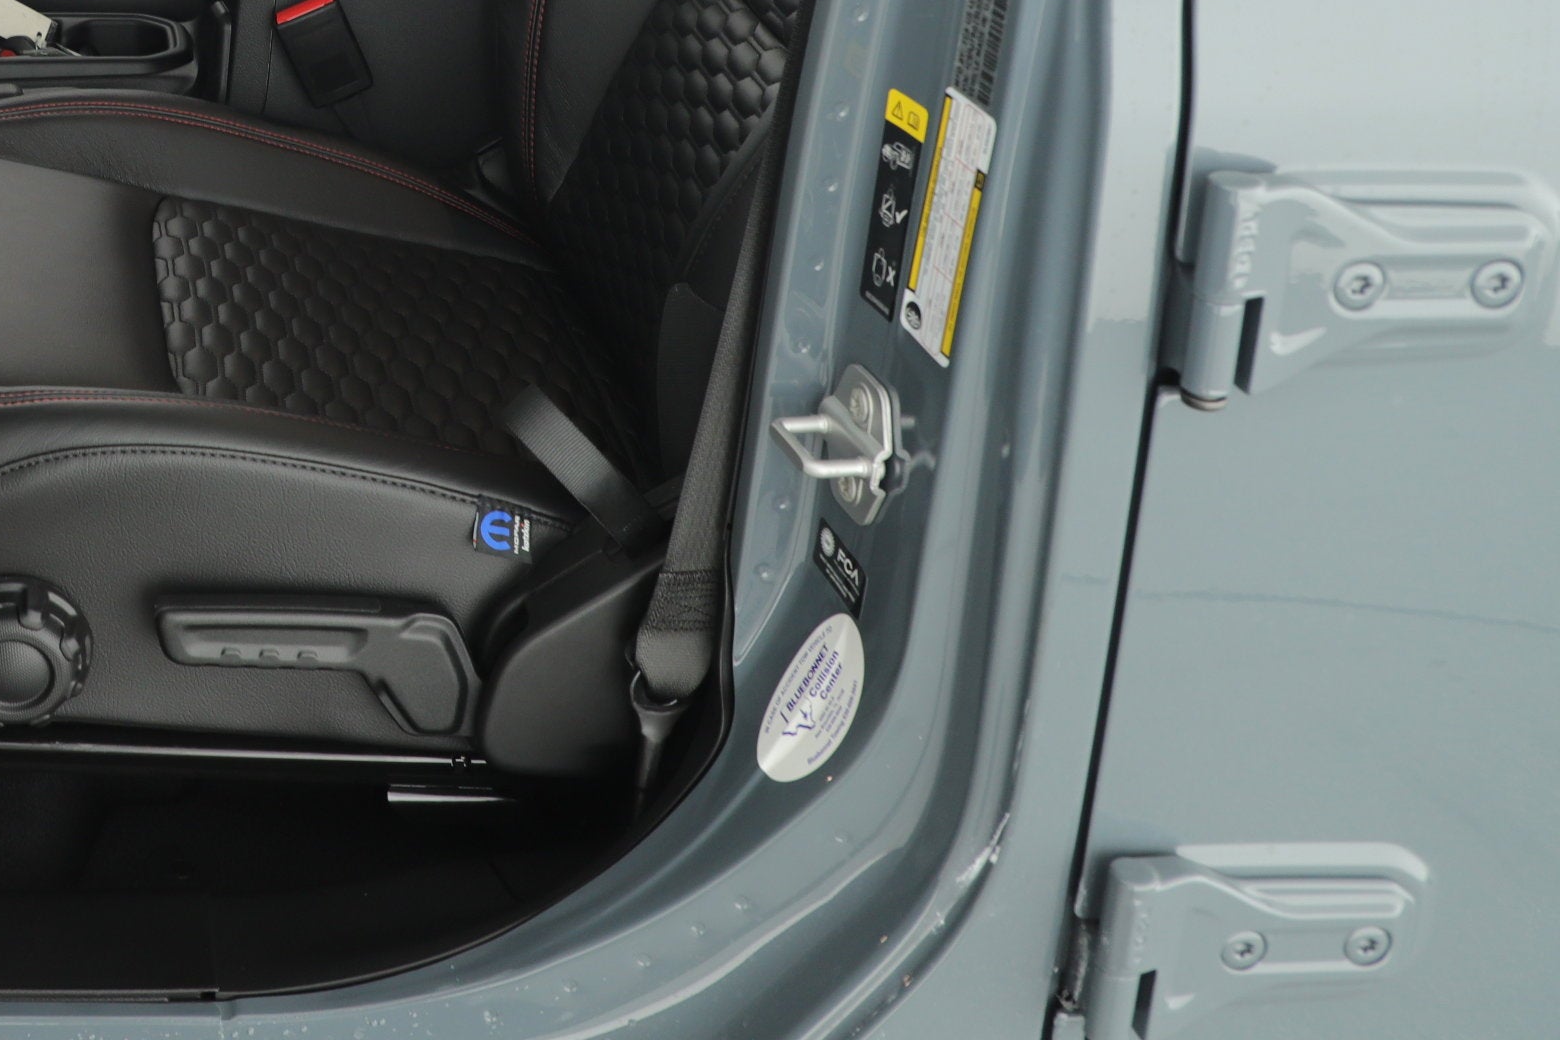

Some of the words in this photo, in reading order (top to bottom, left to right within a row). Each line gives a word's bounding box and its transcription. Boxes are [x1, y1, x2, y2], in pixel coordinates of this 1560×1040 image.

[837, 548, 859, 586] FCA
[786, 644, 829, 712] BLUEBONNET
[809, 650, 839, 697] Collision
[820, 663, 842, 700] Center
